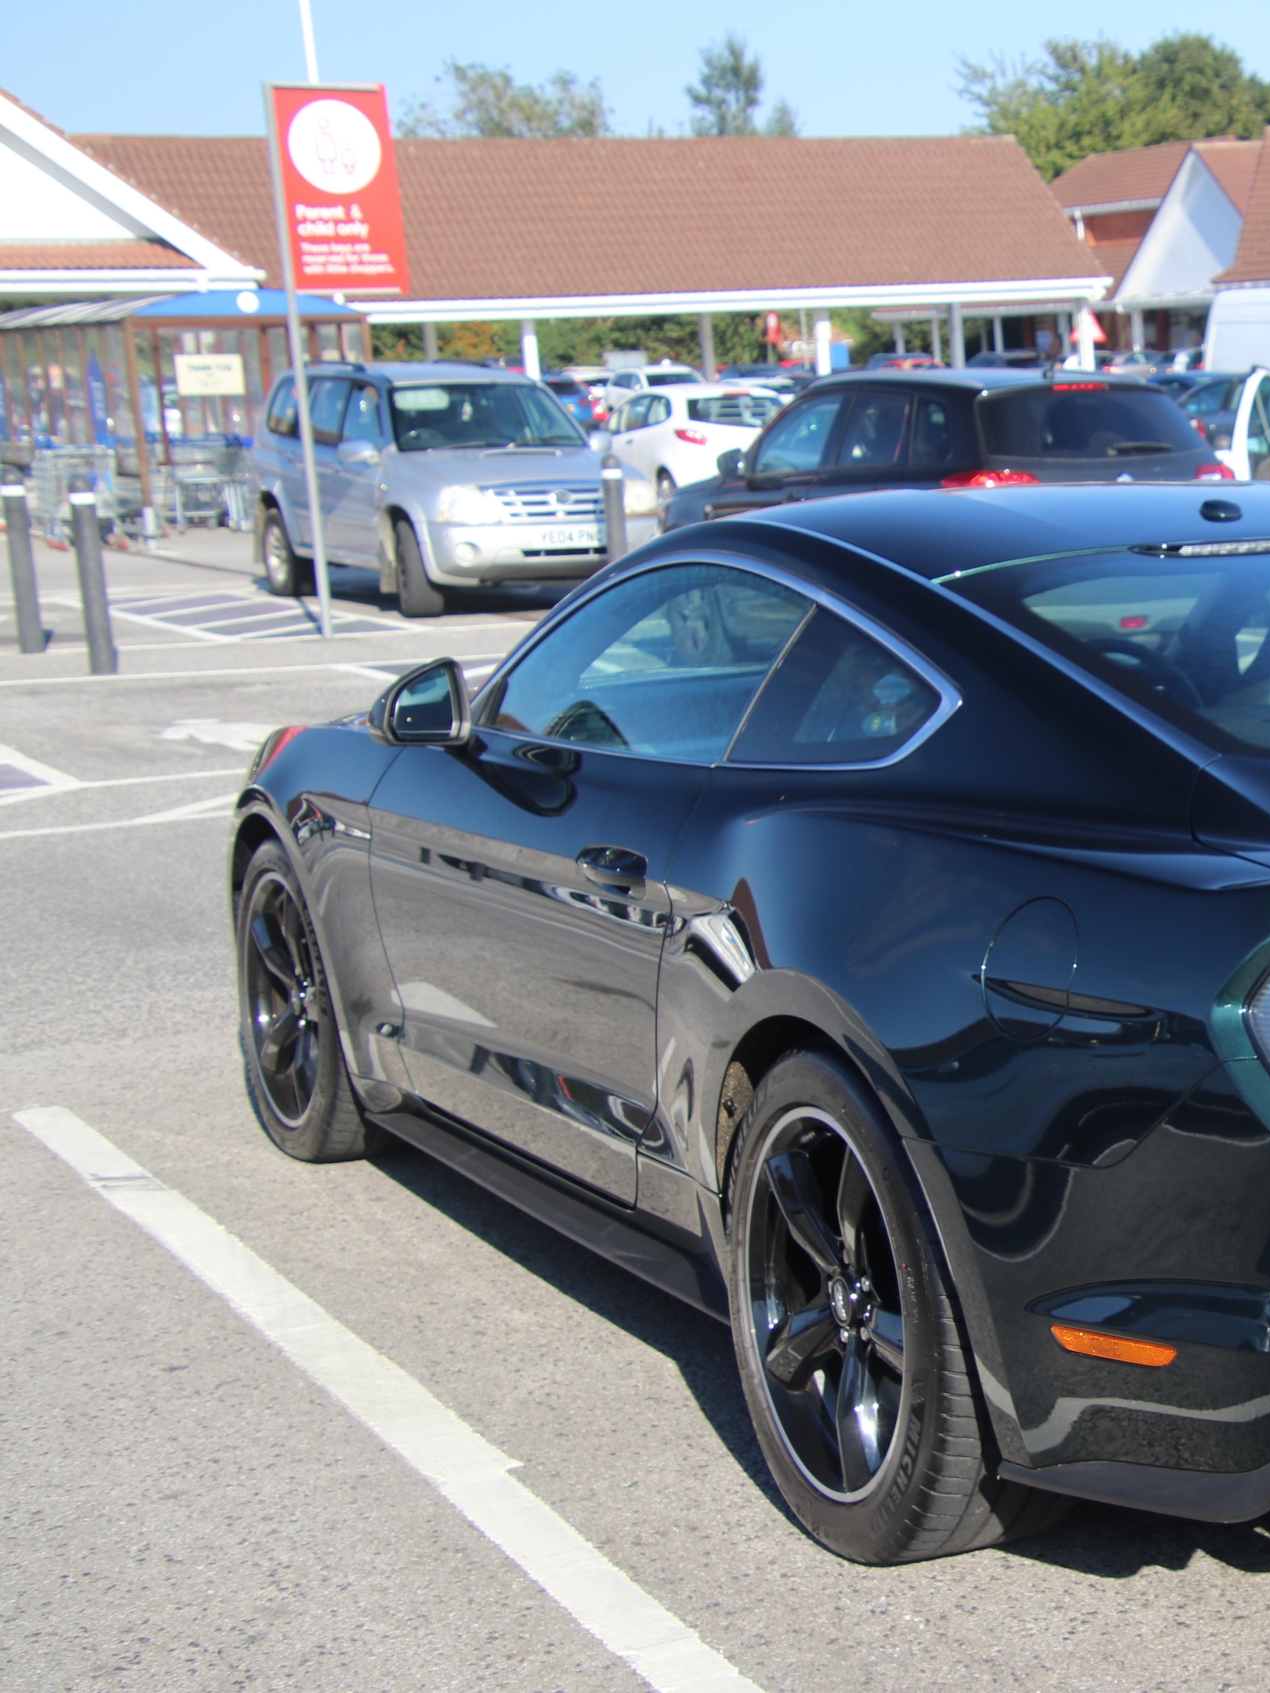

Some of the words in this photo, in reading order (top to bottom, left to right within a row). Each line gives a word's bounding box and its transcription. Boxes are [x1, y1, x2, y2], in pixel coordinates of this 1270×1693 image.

[295, 203, 347, 221] Parent
[350, 203, 363, 220] &
[298, 220, 336, 237] child
[336, 220, 370, 240] only
